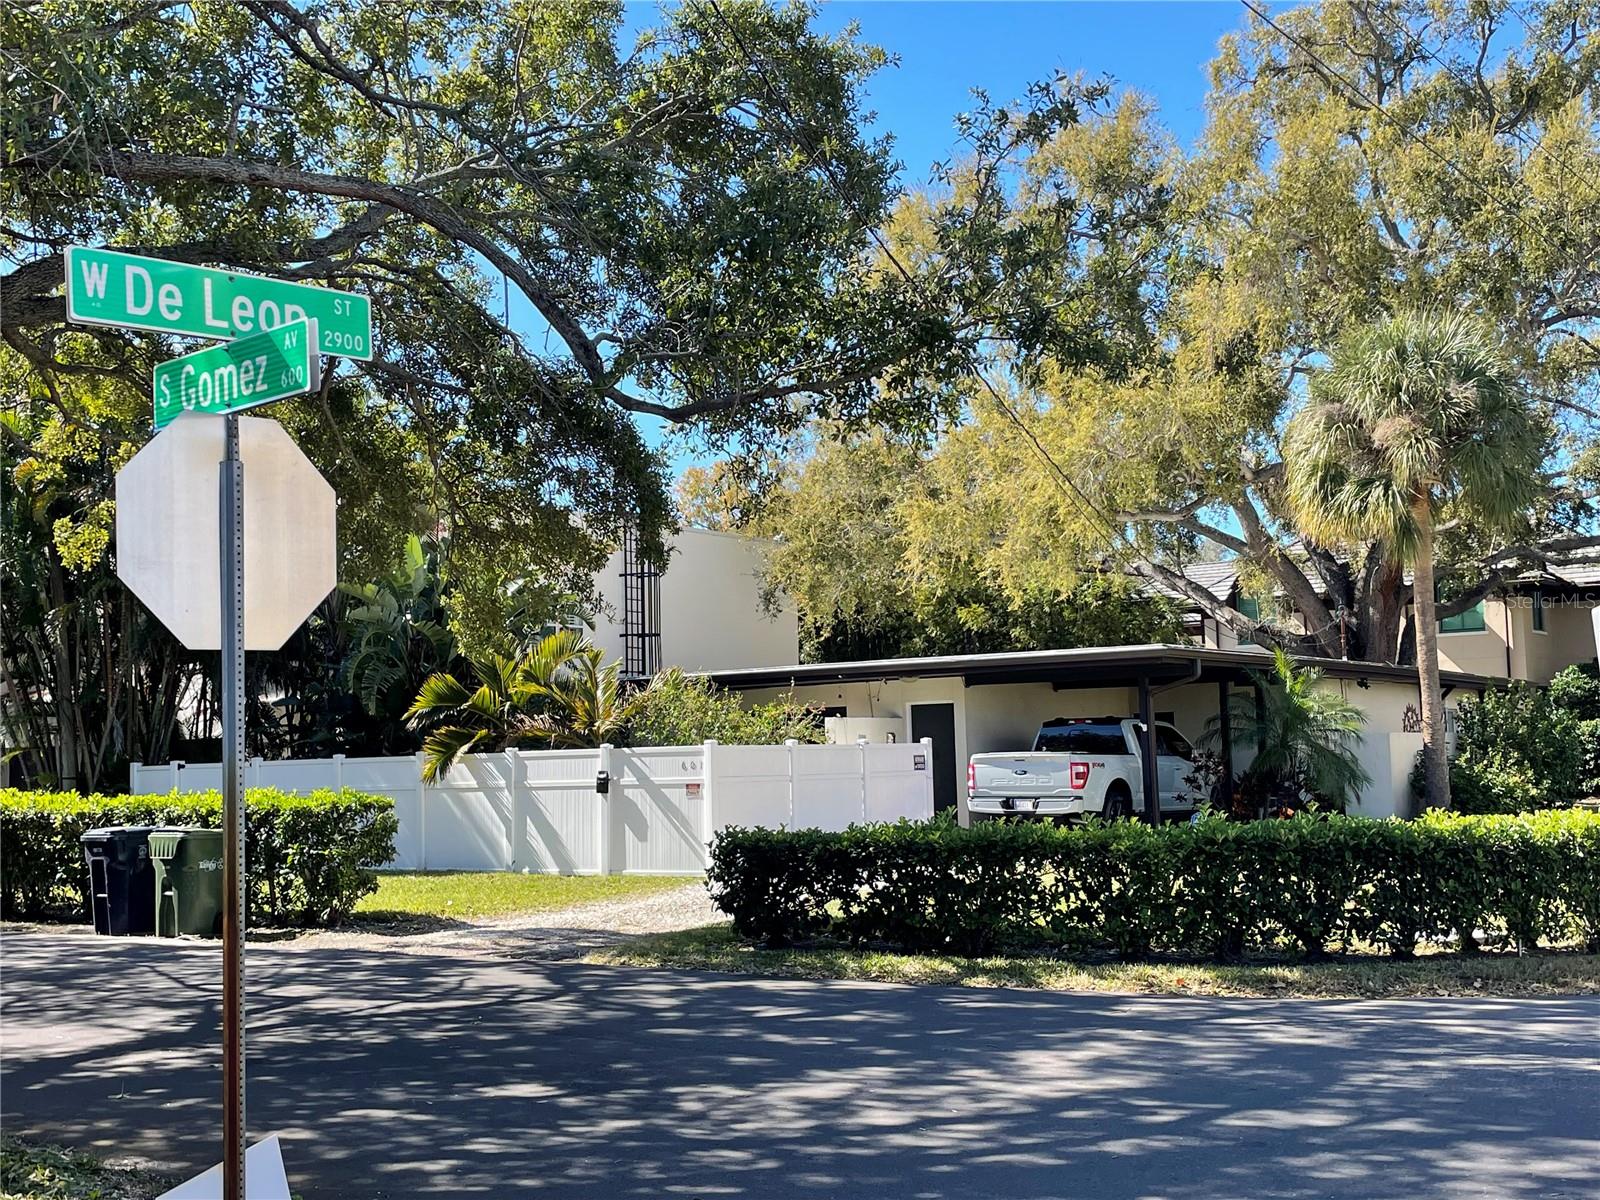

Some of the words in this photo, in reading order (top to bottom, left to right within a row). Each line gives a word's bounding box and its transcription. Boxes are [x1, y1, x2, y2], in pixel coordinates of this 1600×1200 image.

[80, 260, 109, 299] W
[125, 264, 183, 321] De
[334, 299, 351, 316] ST
[324, 330, 363, 352] 2900
[160, 374, 171, 408] S
[181, 355, 268, 411] Gomez
[284, 330, 298, 350] AV
[281, 365, 303, 387] 600
